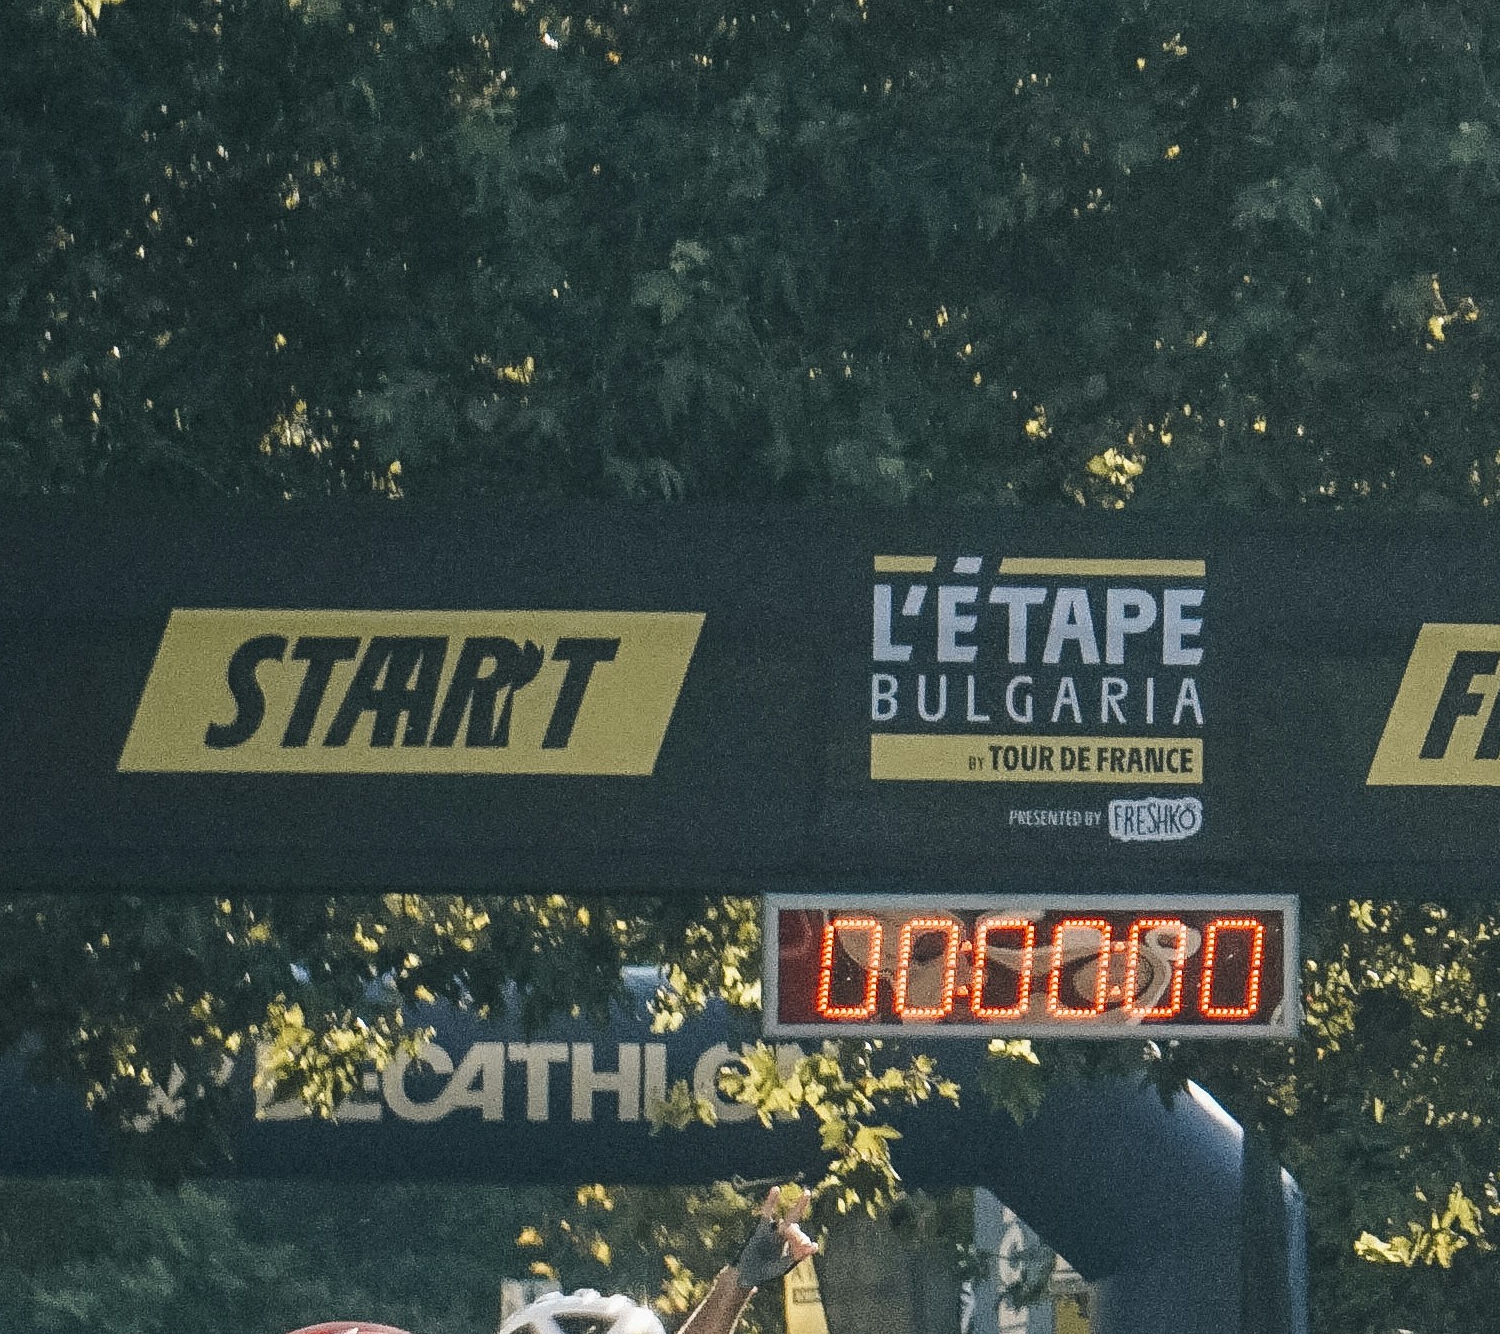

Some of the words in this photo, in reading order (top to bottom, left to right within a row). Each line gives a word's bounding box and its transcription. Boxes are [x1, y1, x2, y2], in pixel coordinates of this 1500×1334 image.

[873, 557, 1203, 666] L'ÉTAPE
[871, 672, 1203, 725] BULGARIA
[968, 755, 984, 772] BY
[988, 744, 1055, 773] TOUR
[1059, 747, 1091, 773] DE
[1096, 747, 1195, 775] FRANCE
[1009, 808, 1079, 827] PRESENTED
[1080, 809, 1102, 827] BY
